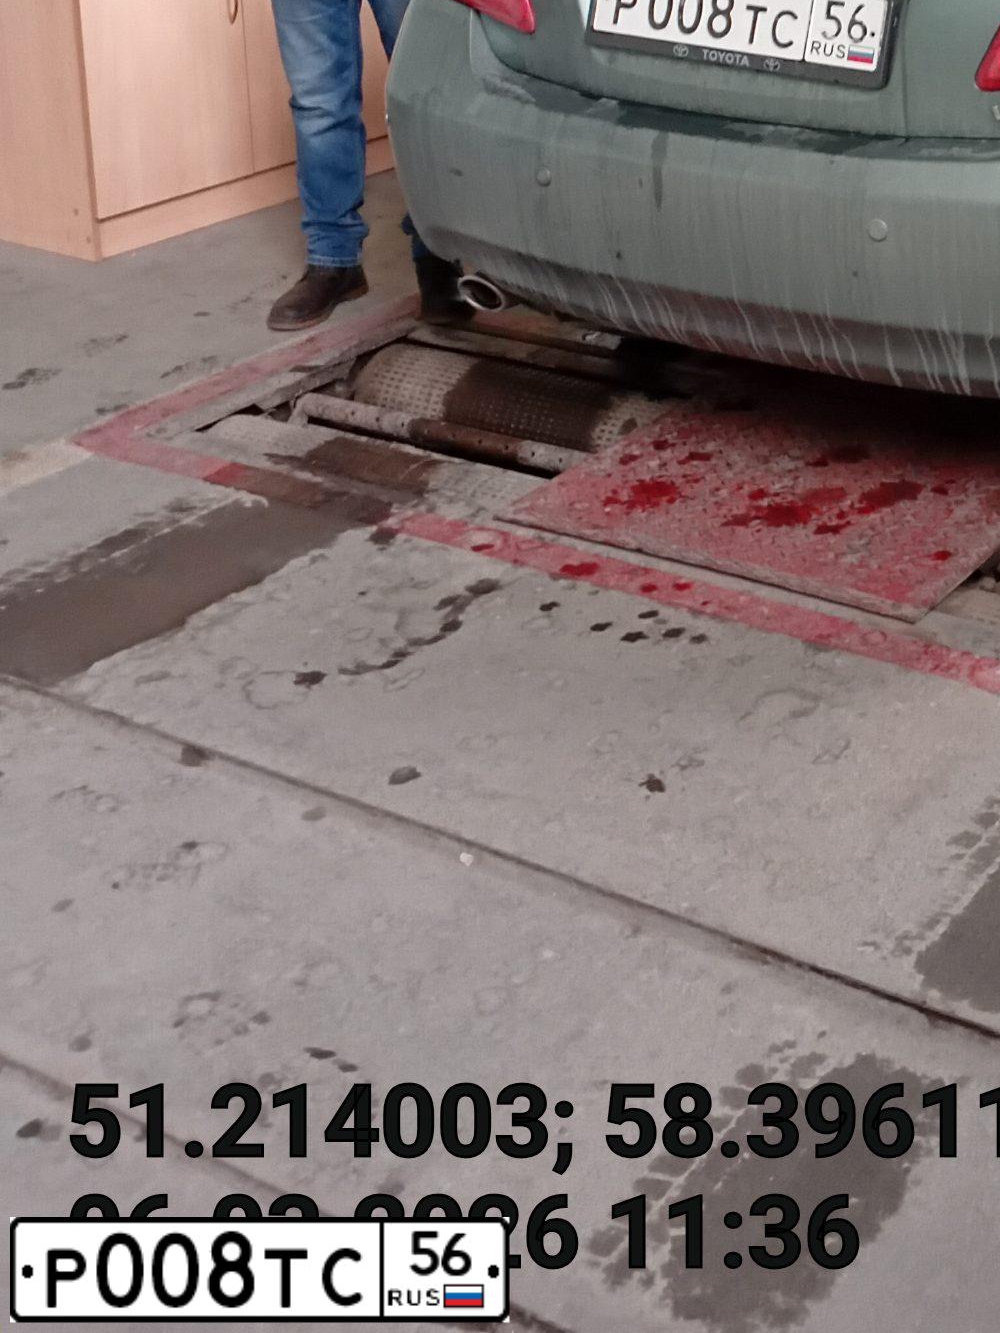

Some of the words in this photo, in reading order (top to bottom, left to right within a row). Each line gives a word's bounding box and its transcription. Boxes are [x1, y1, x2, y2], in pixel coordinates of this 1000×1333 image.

[821, 0, 868, 44] 56
[702, 48, 750, 67] TOYOTA
[809, 40, 846, 60] RUS
